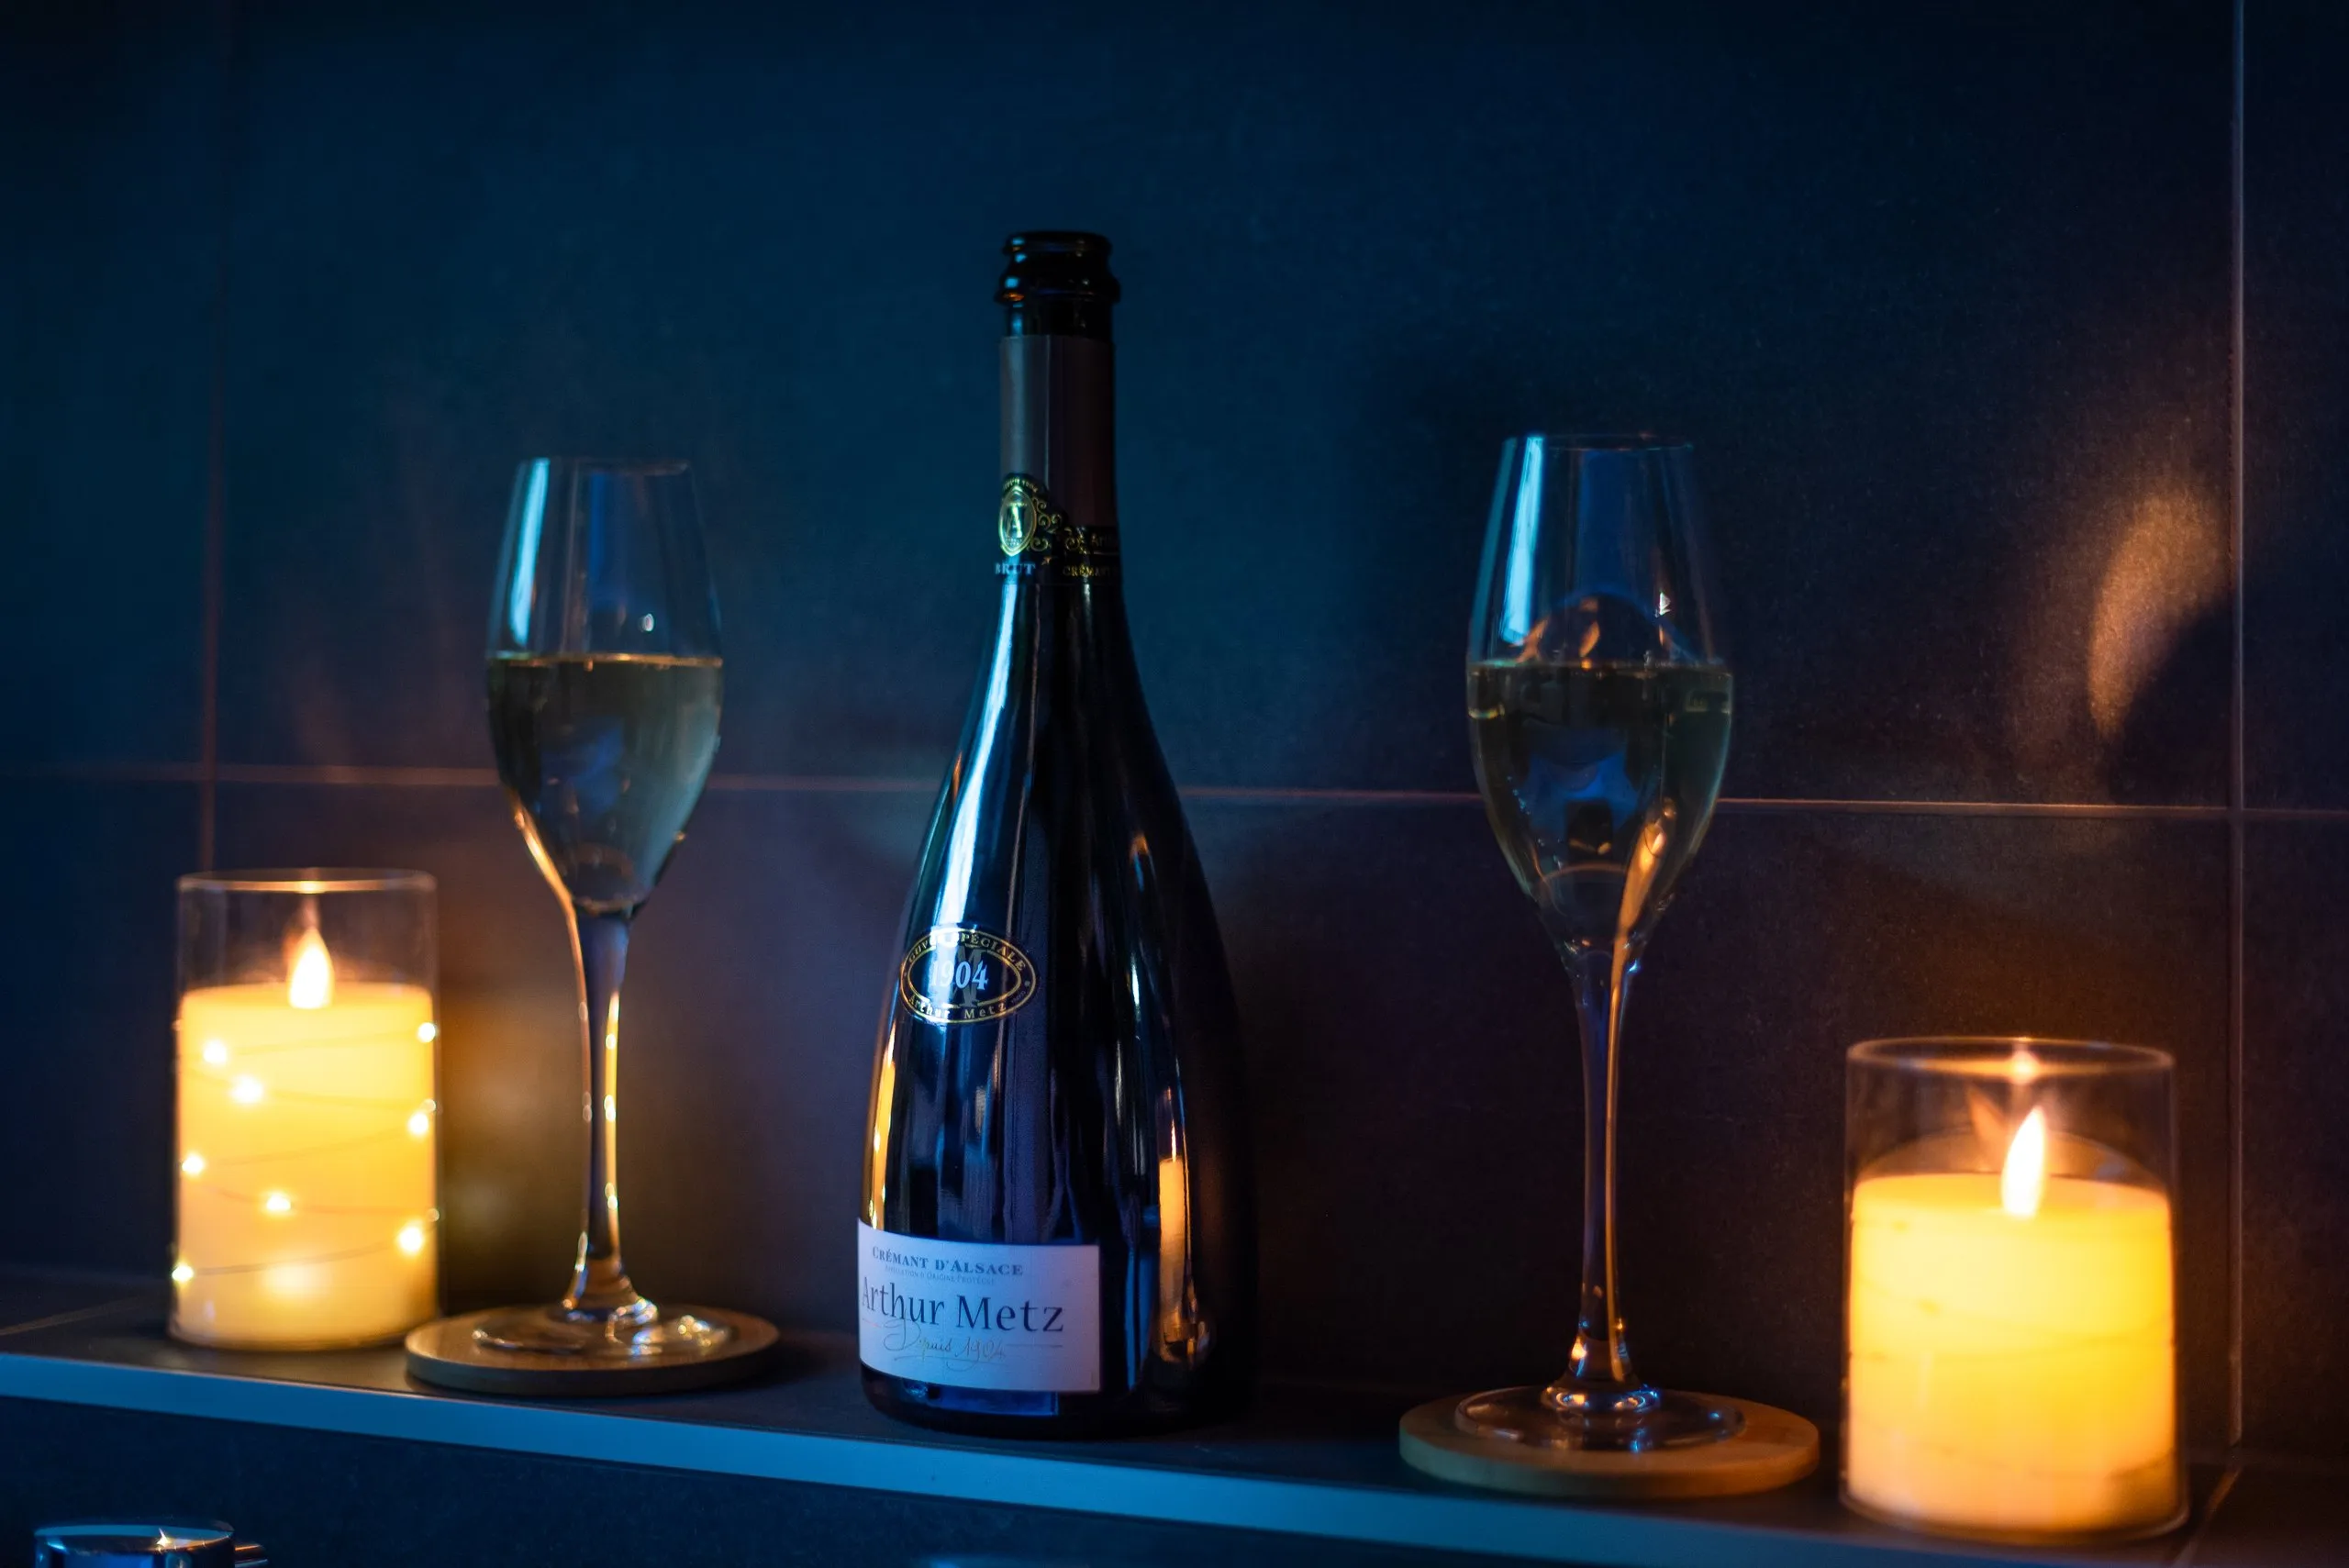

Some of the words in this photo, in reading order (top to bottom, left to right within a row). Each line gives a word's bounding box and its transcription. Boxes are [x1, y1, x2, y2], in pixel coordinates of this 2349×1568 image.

[995, 562, 1036, 575] BRUT
[1063, 563, 1110, 577] CRÉMA
[956, 933, 1025, 973] PÉCIALE
[930, 961, 988, 991] 1904
[909, 994, 951, 1018] Arthur
[963, 1003, 1007, 1019] Metz
[872, 1246, 929, 1269] CRÉMANT
[935, 1259, 1024, 1276] D'ALSACE
[862, 1276, 944, 1325] Arthur
[956, 1295, 1064, 1332] Metz
